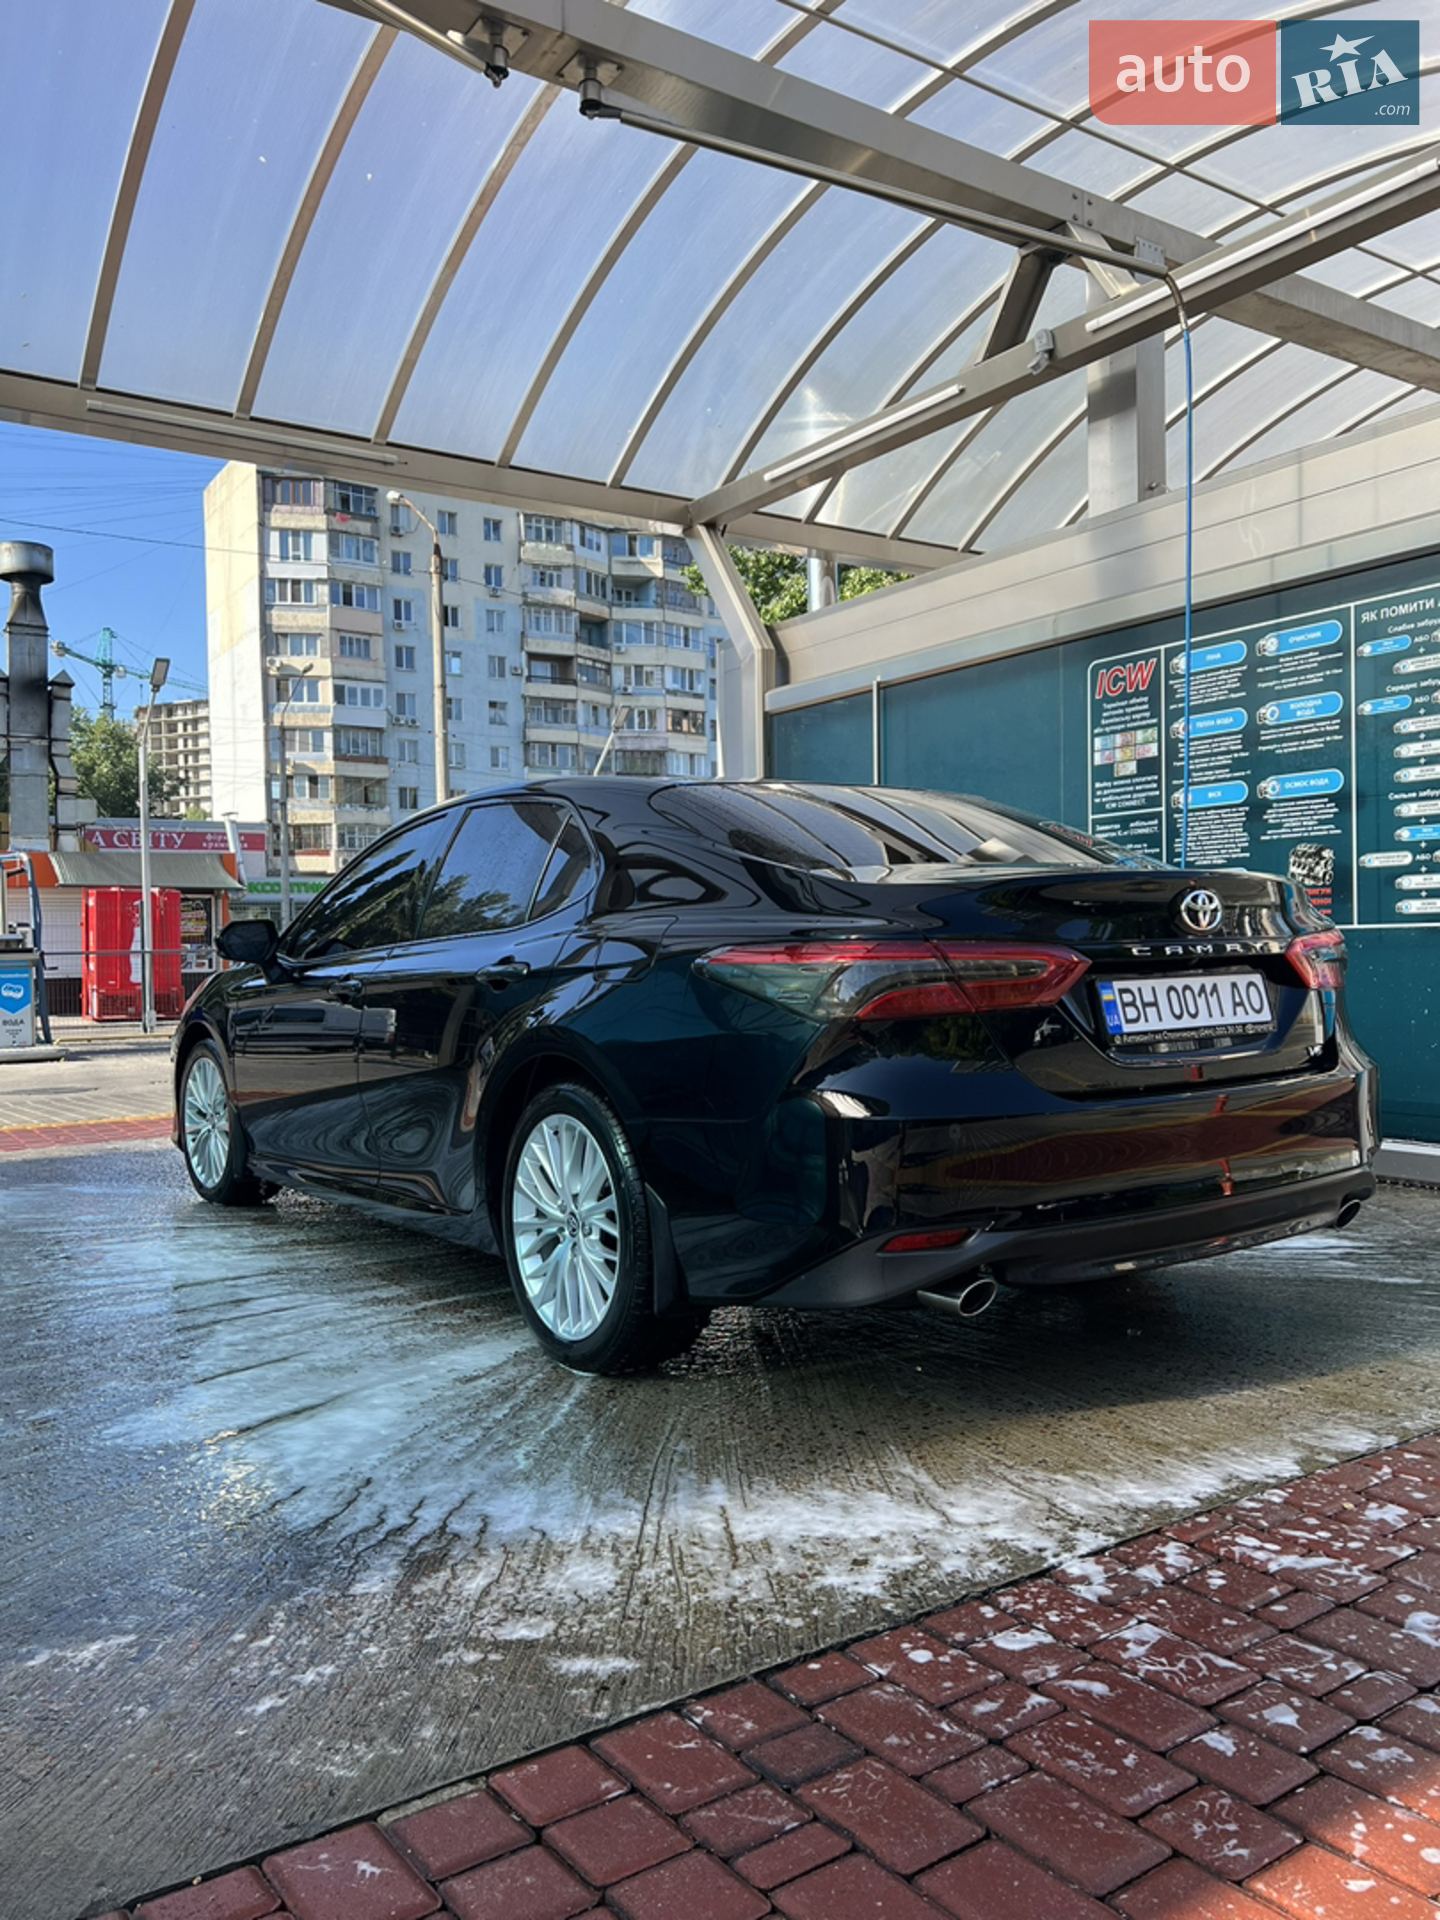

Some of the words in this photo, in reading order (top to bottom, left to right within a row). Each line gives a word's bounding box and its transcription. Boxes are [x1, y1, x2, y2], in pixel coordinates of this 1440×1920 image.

[1361, 609, 1378, 624] ЯК
[1380, 597, 1435, 620] ПОМИТИ
[1288, 630, 1322, 644] ОЧИСНИК
[1095, 657, 1158, 699] ICW
[1284, 779, 1309, 790] ОСМОС
[1309, 777, 1330, 788] ВОДА
[1117, 985, 1163, 1025] BH
[1166, 982, 1225, 1021] 0011
[1231, 979, 1266, 1017] AO
[1106, 1014, 1120, 1027] UA
